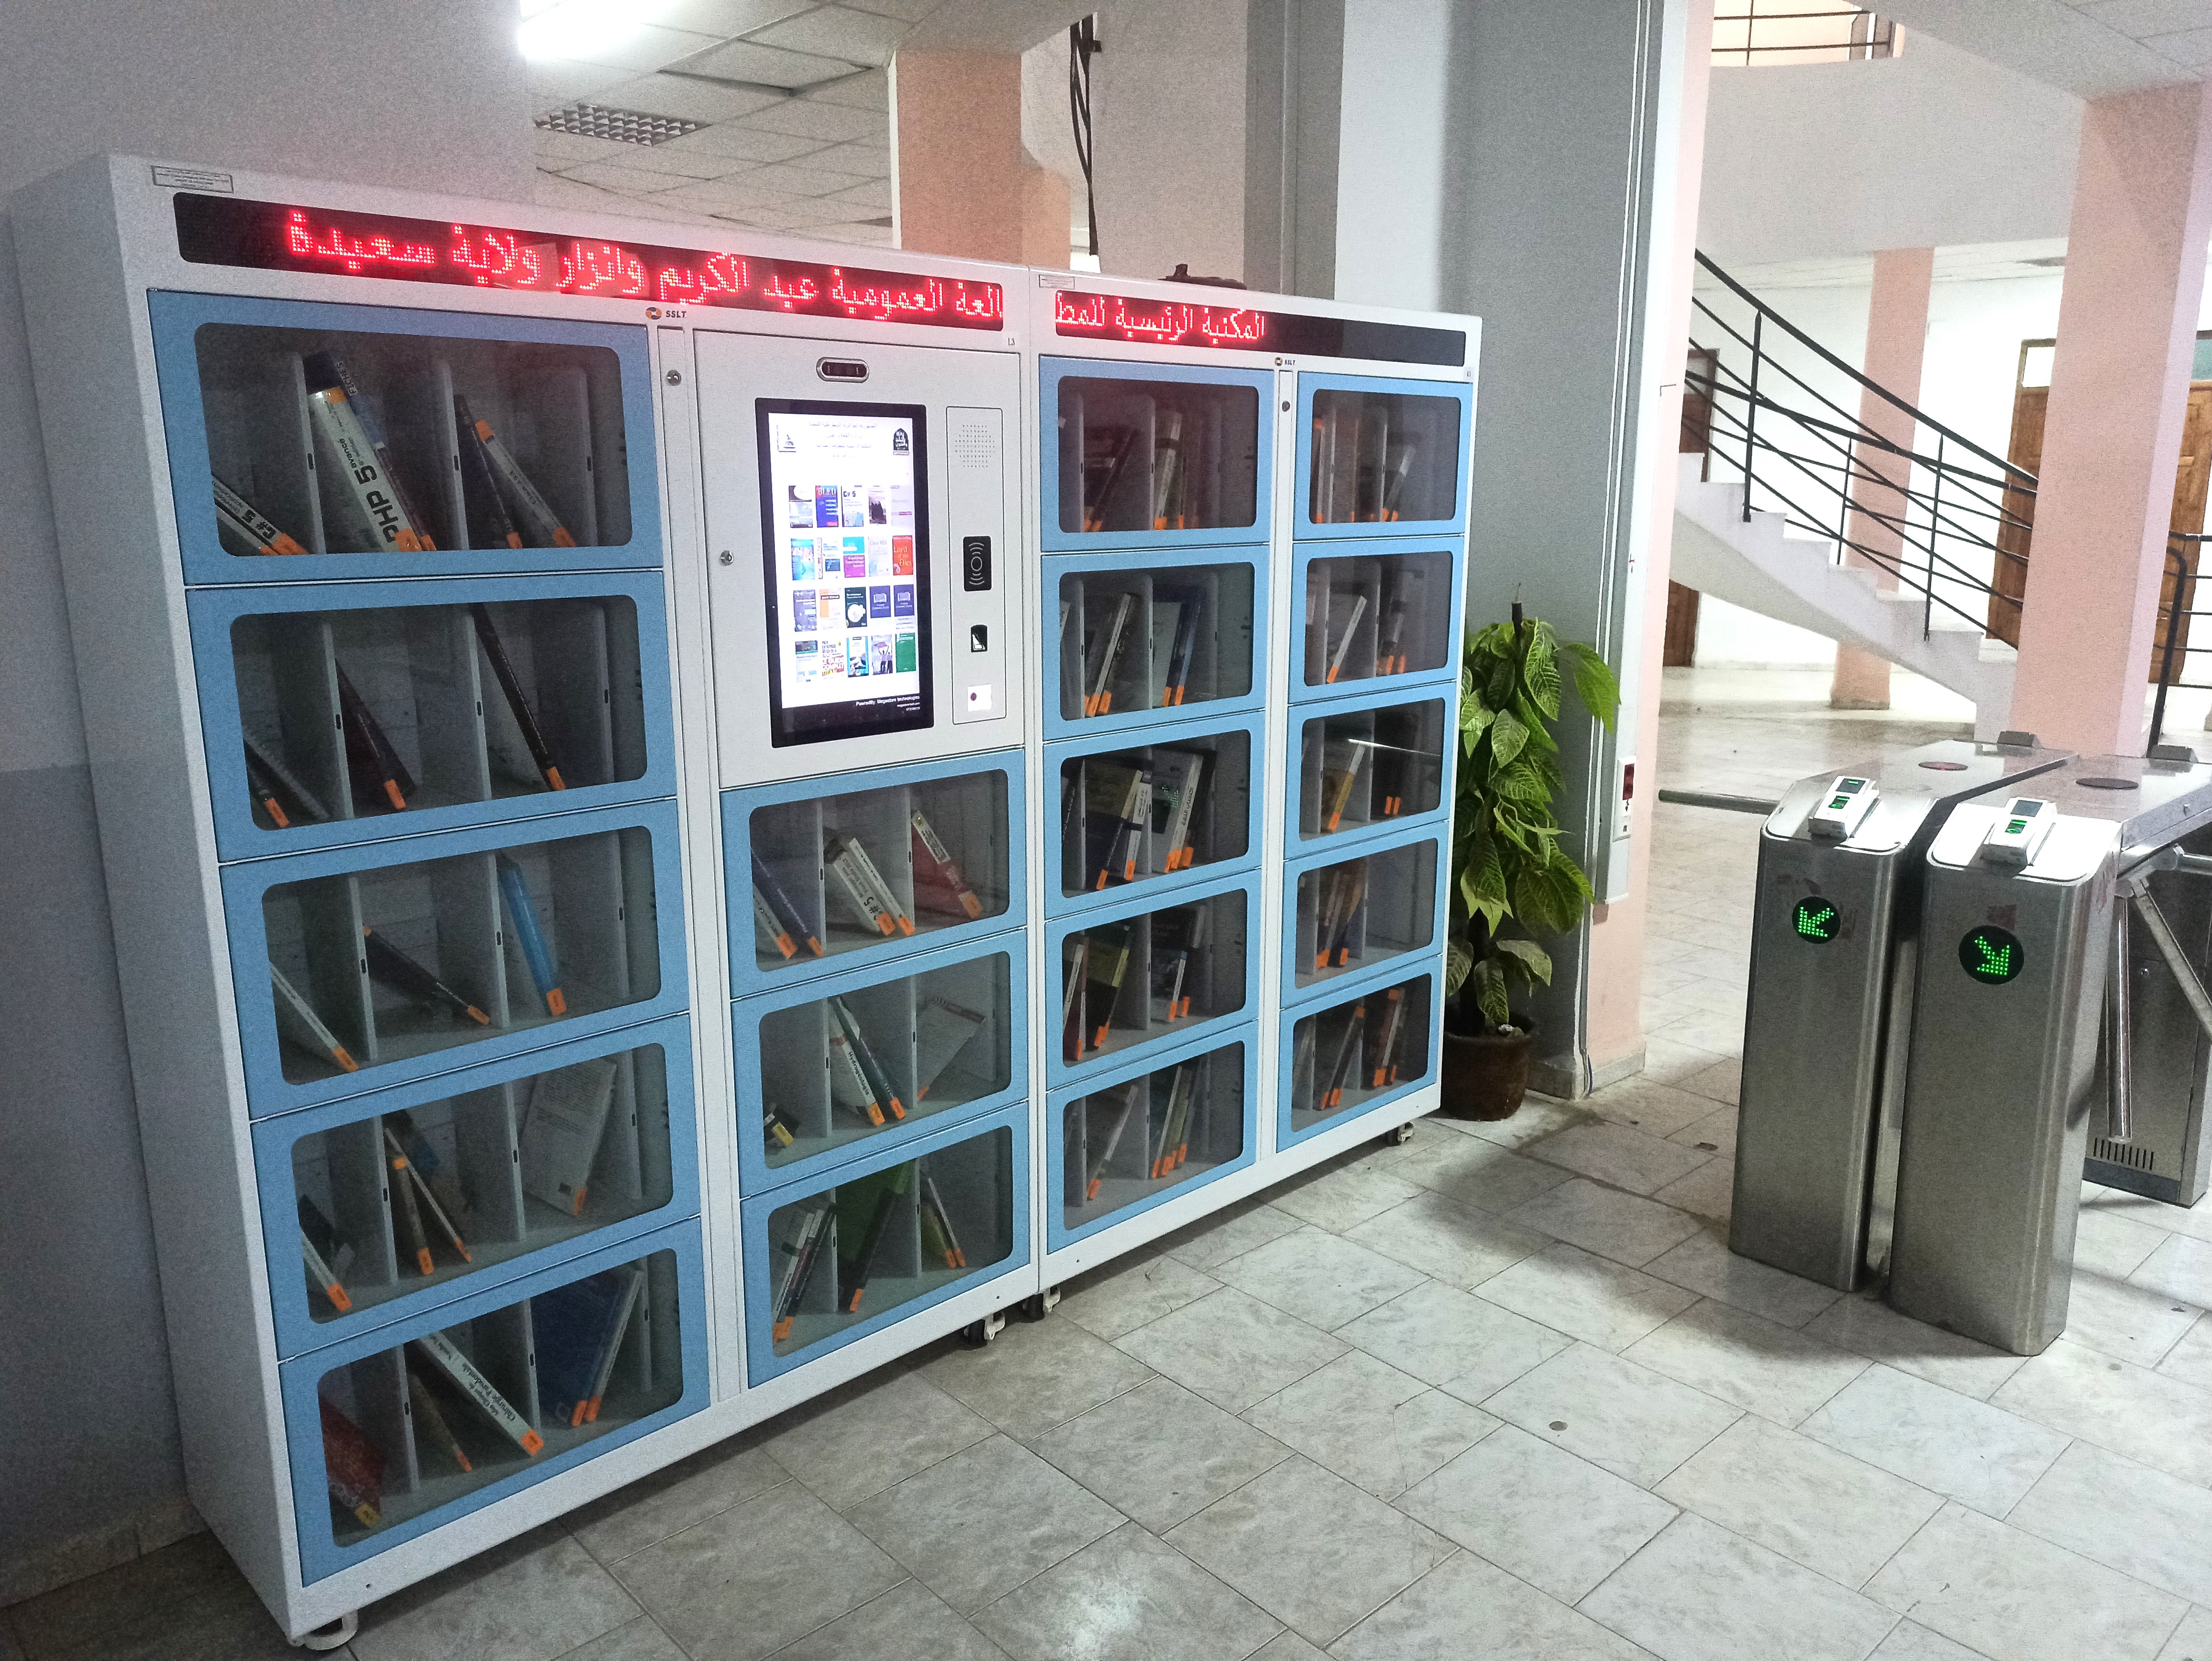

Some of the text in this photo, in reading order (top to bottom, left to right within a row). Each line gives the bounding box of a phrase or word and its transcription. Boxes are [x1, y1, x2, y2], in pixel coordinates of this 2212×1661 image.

[290, 212, 435, 269] سعيدة
[453, 228, 541, 285] ولاية
[659, 252, 750, 305] الكريم
[763, 275, 820, 308] عبد
[831, 268, 944, 321] العمومية
[665, 310, 686, 318] SSLT
[1114, 298, 1193, 341] الرئيسية
[1201, 307, 1264, 346] المكتبة
[1008, 337, 1015, 345] L3
[336, 362, 357, 396] FICHES
[339, 437, 357, 468] avancé
[354, 465, 399, 543] PHP 5
[241, 509, 276, 540] C# 5
[863, 896, 874, 907] 5
